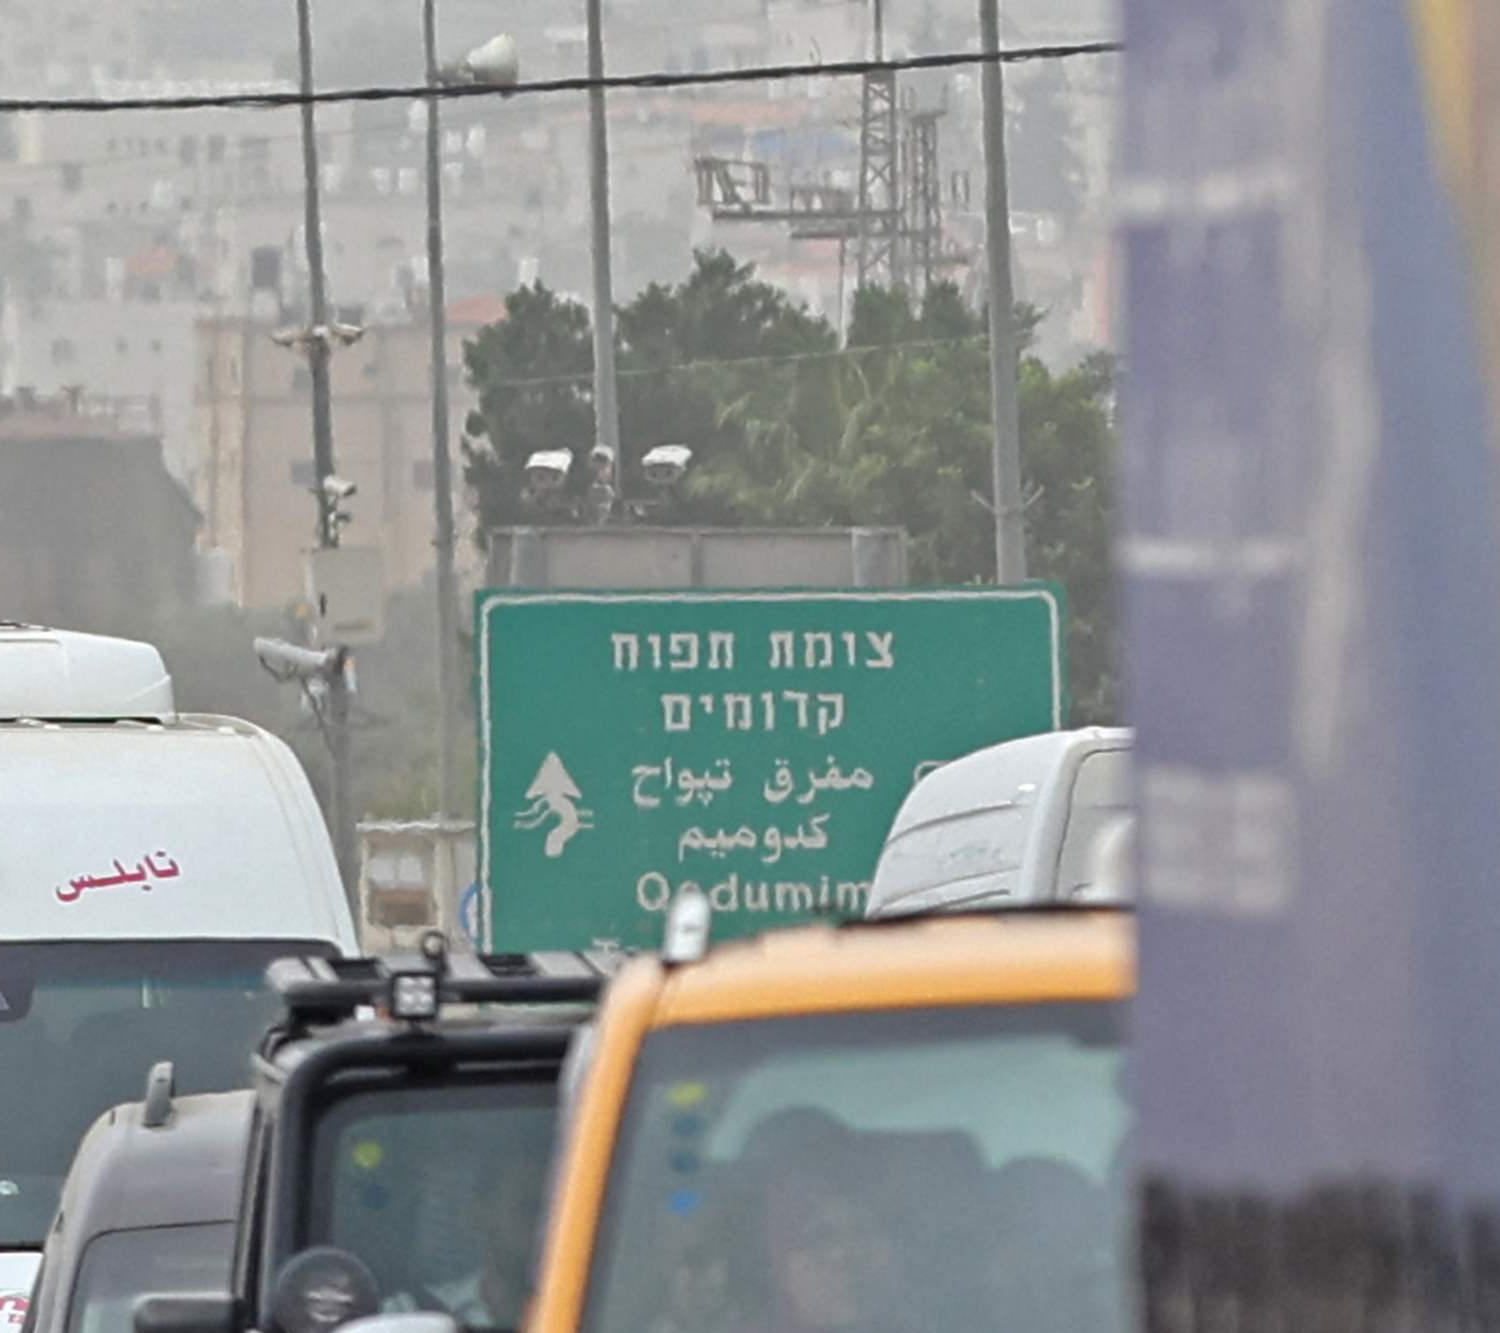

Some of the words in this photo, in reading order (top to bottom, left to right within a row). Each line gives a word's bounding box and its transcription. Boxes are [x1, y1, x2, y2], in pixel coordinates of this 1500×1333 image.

[610, 629, 737, 671] תפוח
[768, 629, 896, 670] צומת
[661, 691, 846, 735] קדומים
[763, 752, 875, 803] مفرق
[678, 813, 833, 863] كدوميم
[55, 850, 180, 903] نابلس
